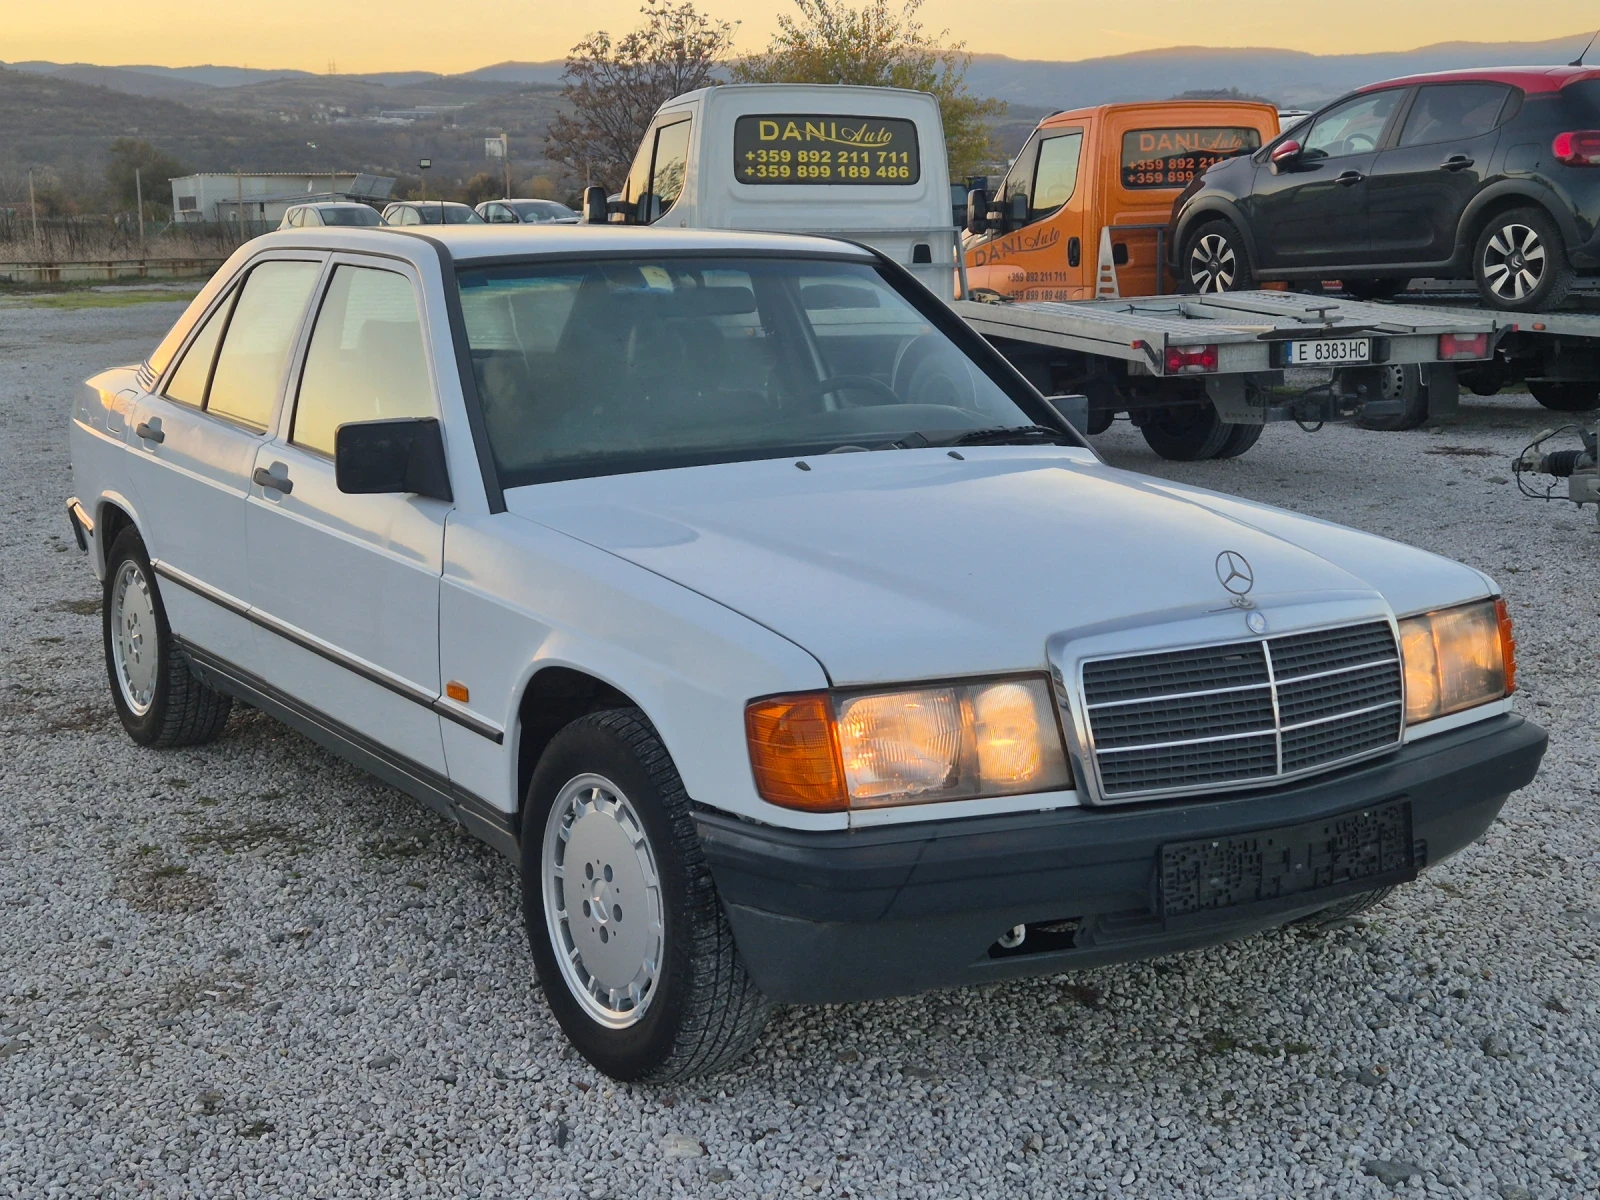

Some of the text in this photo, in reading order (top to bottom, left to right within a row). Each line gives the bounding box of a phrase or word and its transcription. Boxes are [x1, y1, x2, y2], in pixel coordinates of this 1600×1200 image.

[759, 120, 893, 143] DANI Auto
[1140, 132, 1243, 152] DANI Auto
[745, 150, 908, 163] +359 892 211 711
[1128, 159, 1164, 171] +359
[1168, 158, 1194, 170] 892
[744, 165, 909, 178] +359 899 189 486
[1128, 171, 1194, 184] +359 899
[974, 227, 1061, 267] DANI Auto
[1007, 271, 1067, 283] +359 892 211 711
[1025, 290, 1039, 301] 899
[1040, 290, 1053, 301] 189
[1054, 290, 1068, 300] 486
[1299, 341, 1367, 361] E 8383 HC
